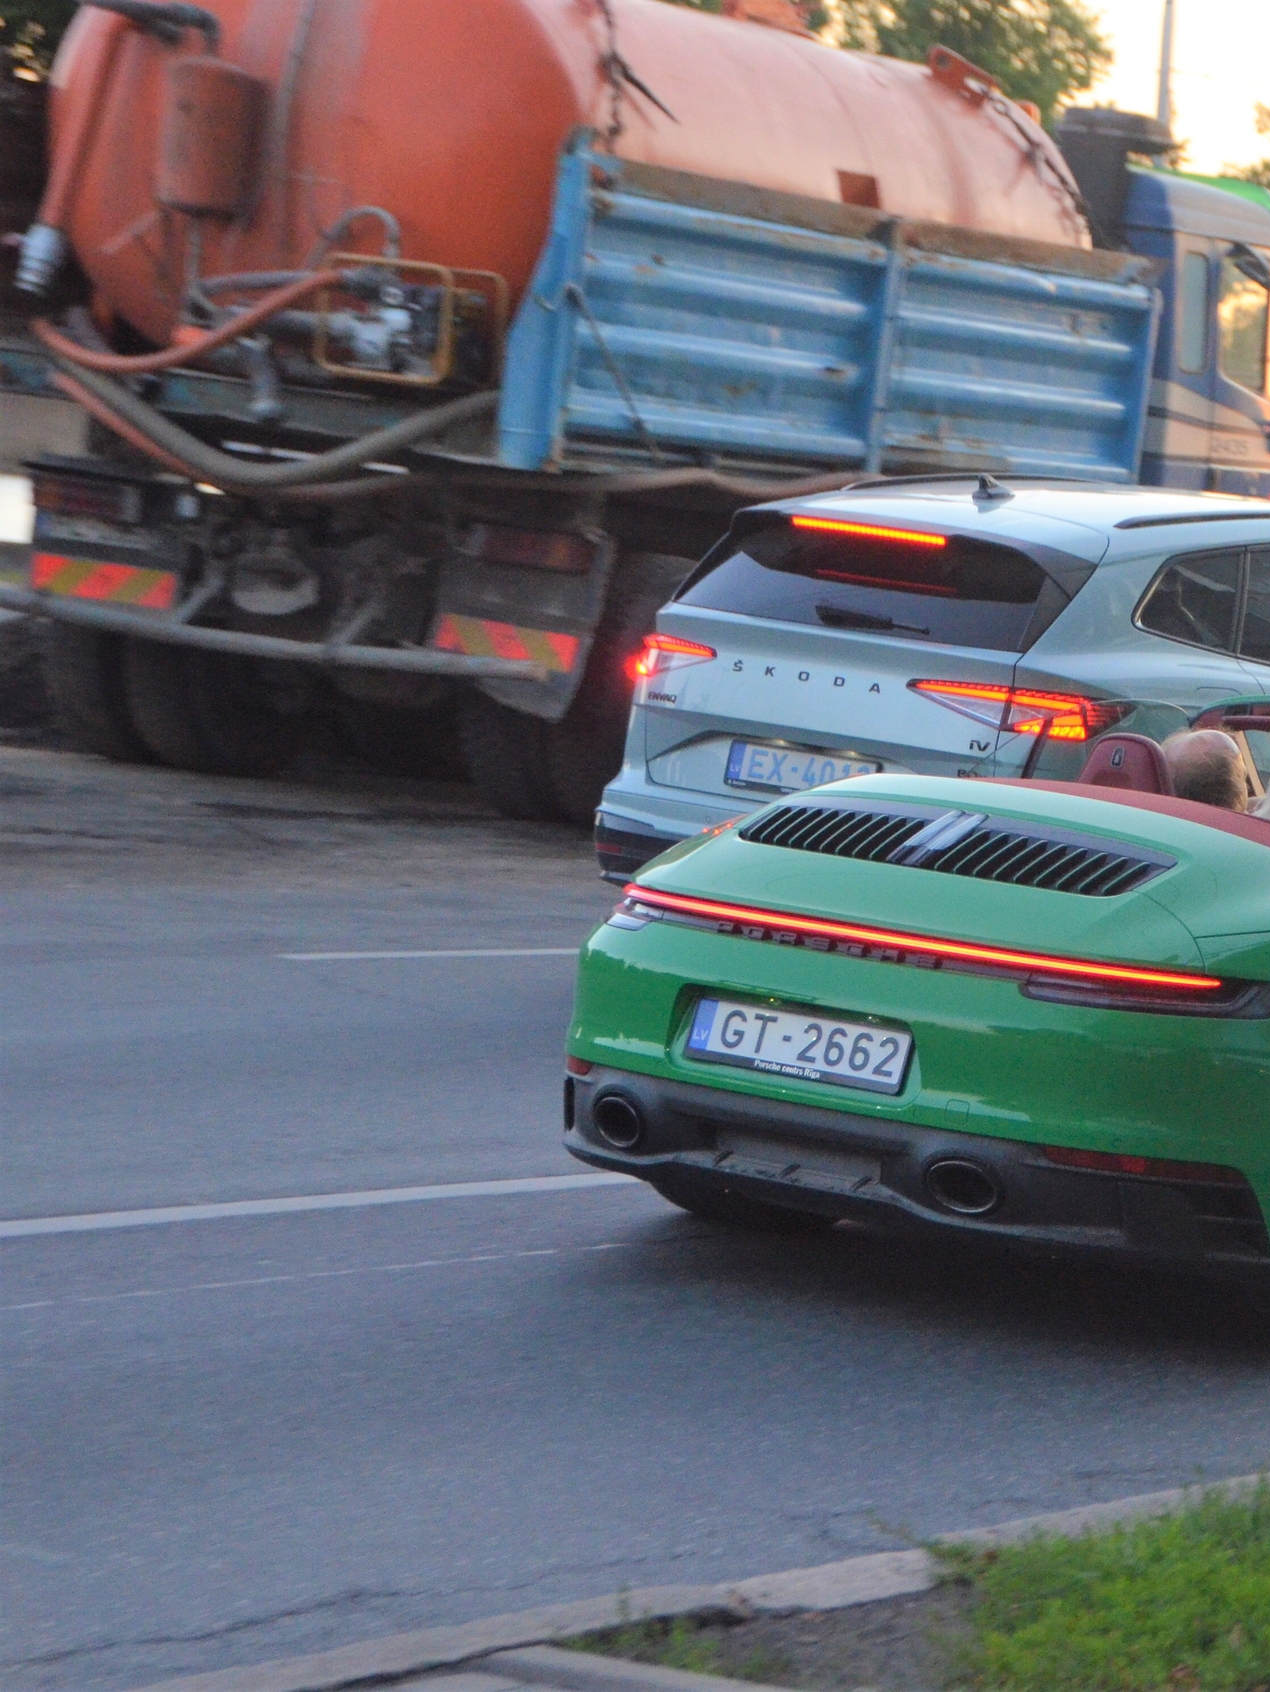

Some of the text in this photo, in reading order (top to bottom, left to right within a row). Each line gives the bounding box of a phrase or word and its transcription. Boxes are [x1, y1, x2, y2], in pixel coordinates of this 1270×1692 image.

[732, 659, 881, 694] ŠKODA
[694, 1028, 709, 1041] LV
[720, 1009, 900, 1078] GT-2662
[754, 1059, 781, 1072] Porsche
[781, 1064, 803, 1075] centrs
